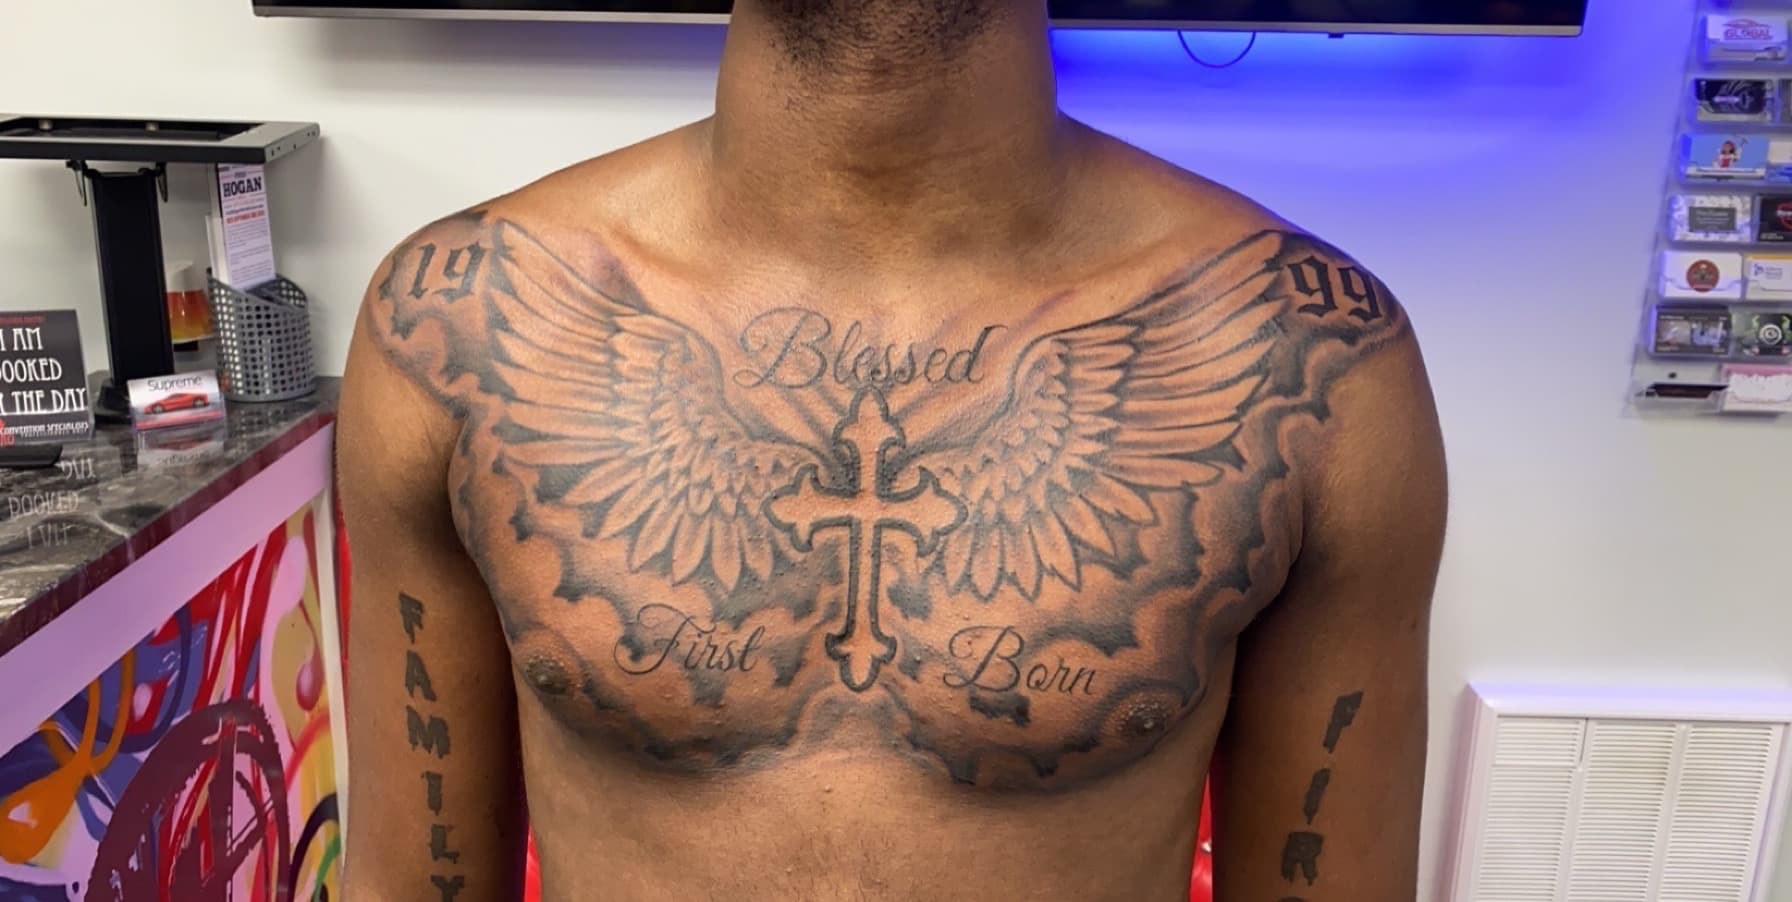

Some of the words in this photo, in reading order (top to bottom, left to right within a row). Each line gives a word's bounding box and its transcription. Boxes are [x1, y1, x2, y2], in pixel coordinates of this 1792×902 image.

[222, 177, 262, 197] HOGAN
[408, 239, 487, 304] 19
[1287, 255, 1382, 322] 99
[0, 358, 62, 383] OOKED
[12, 327, 43, 351] AM
[733, 306, 1008, 389] Blessed
[11, 390, 46, 415] THE
[51, 388, 86, 411] DAY
[147, 375, 203, 392] Supreme
[613, 603, 765, 676] First
[943, 625, 1096, 695] Born
[398, 592, 465, 902] FAMILY
[1276, 691, 1364, 902] FIR
